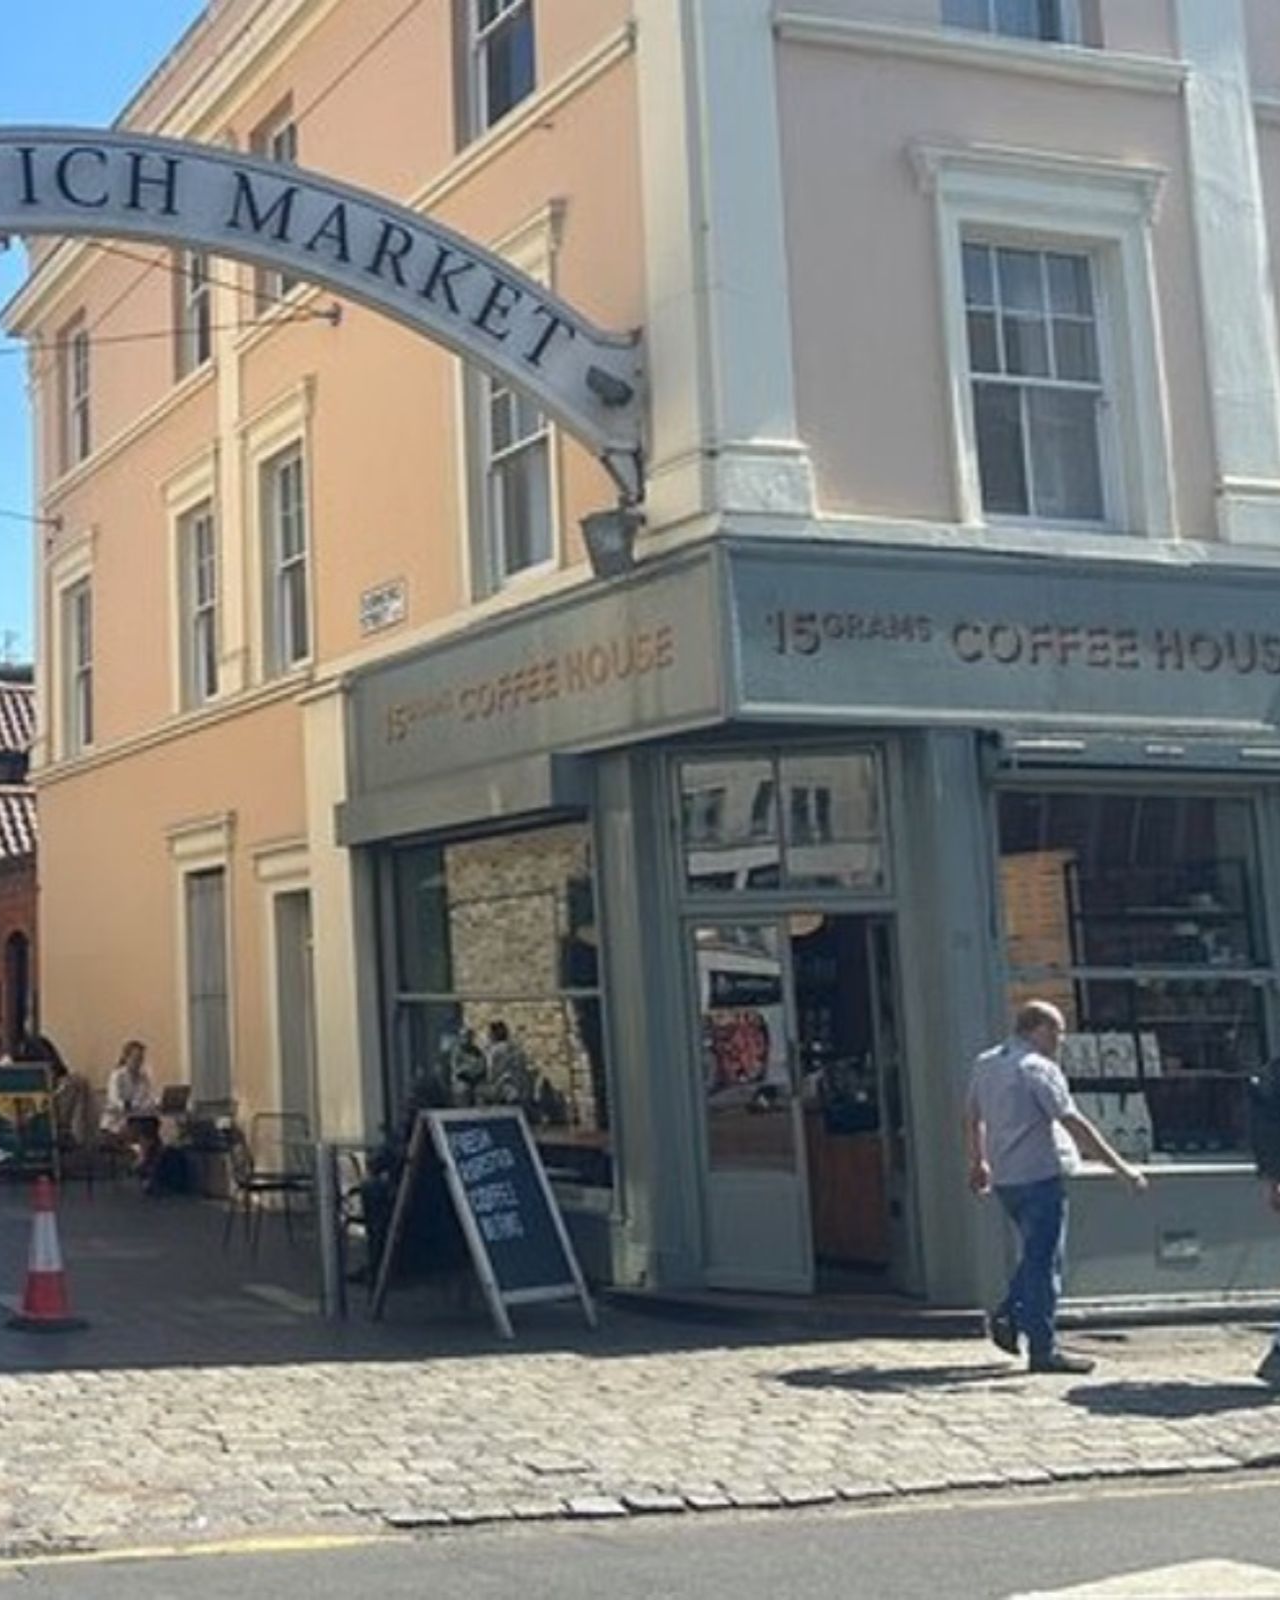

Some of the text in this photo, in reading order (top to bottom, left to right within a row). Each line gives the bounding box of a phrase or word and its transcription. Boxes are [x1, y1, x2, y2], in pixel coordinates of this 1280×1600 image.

[226, 171, 576, 368] MARKET
[459, 658, 559, 723] COFFEE
[564, 624, 675, 693] HOUSE
[950, 621, 1140, 670] COFFEE
